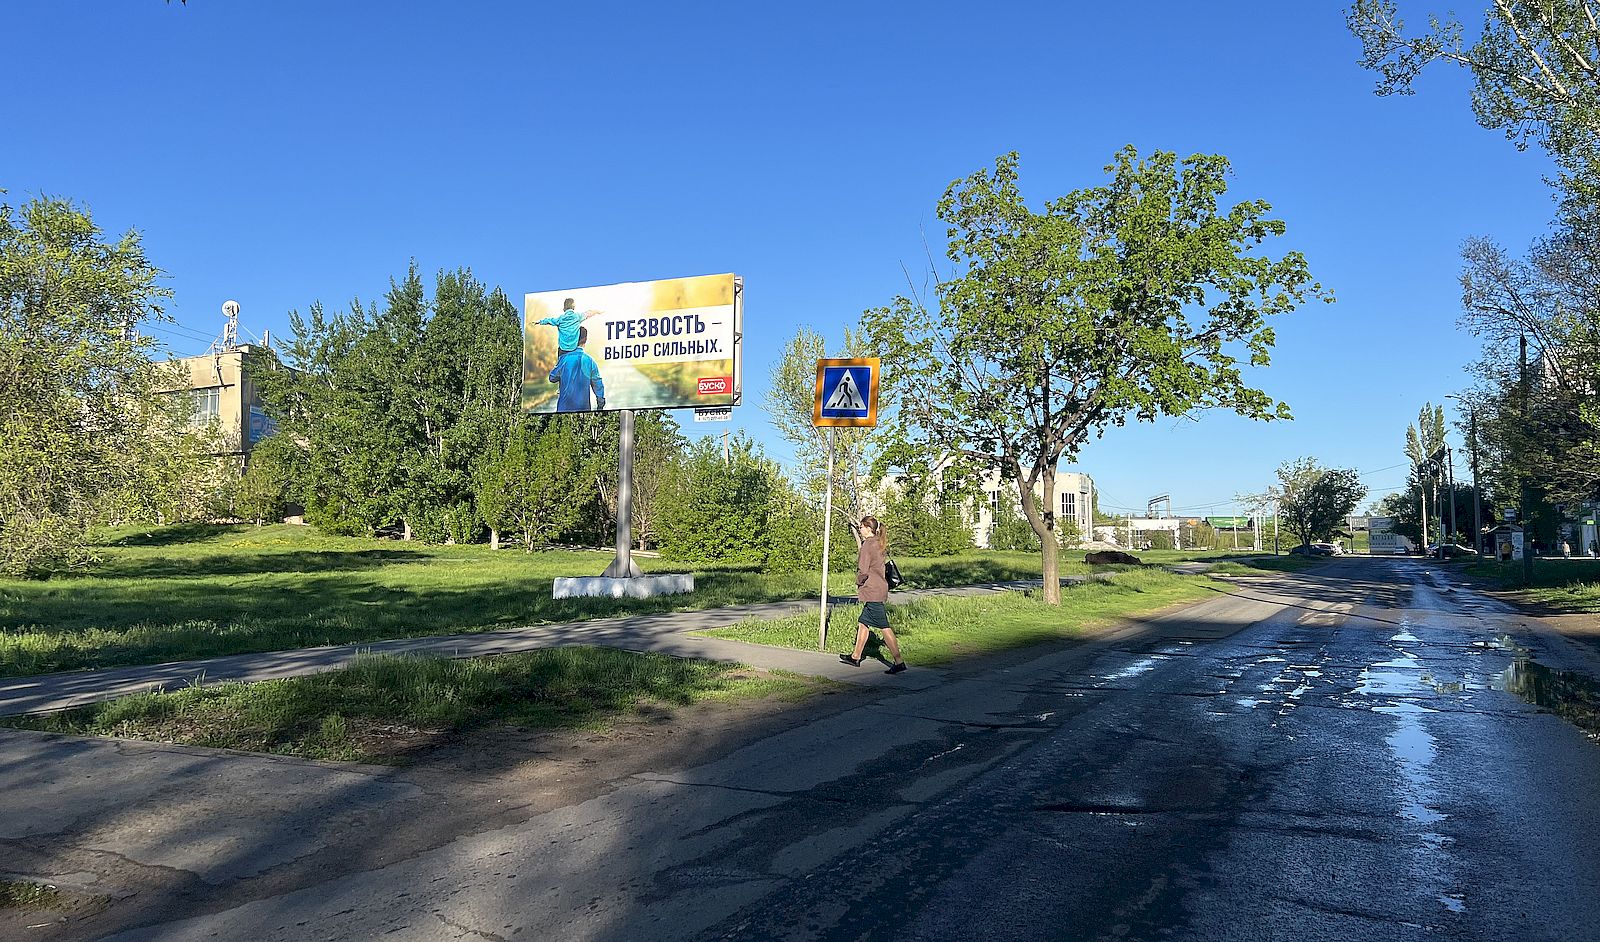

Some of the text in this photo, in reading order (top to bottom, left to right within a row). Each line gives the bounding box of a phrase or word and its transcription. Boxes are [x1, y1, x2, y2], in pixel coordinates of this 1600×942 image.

[605, 314, 705, 340] ТРЕЗВОСТЬ
[604, 338, 723, 360] ВЫБОР СИЛЬНЫХ.
[698, 380, 726, 391] БУСКО
